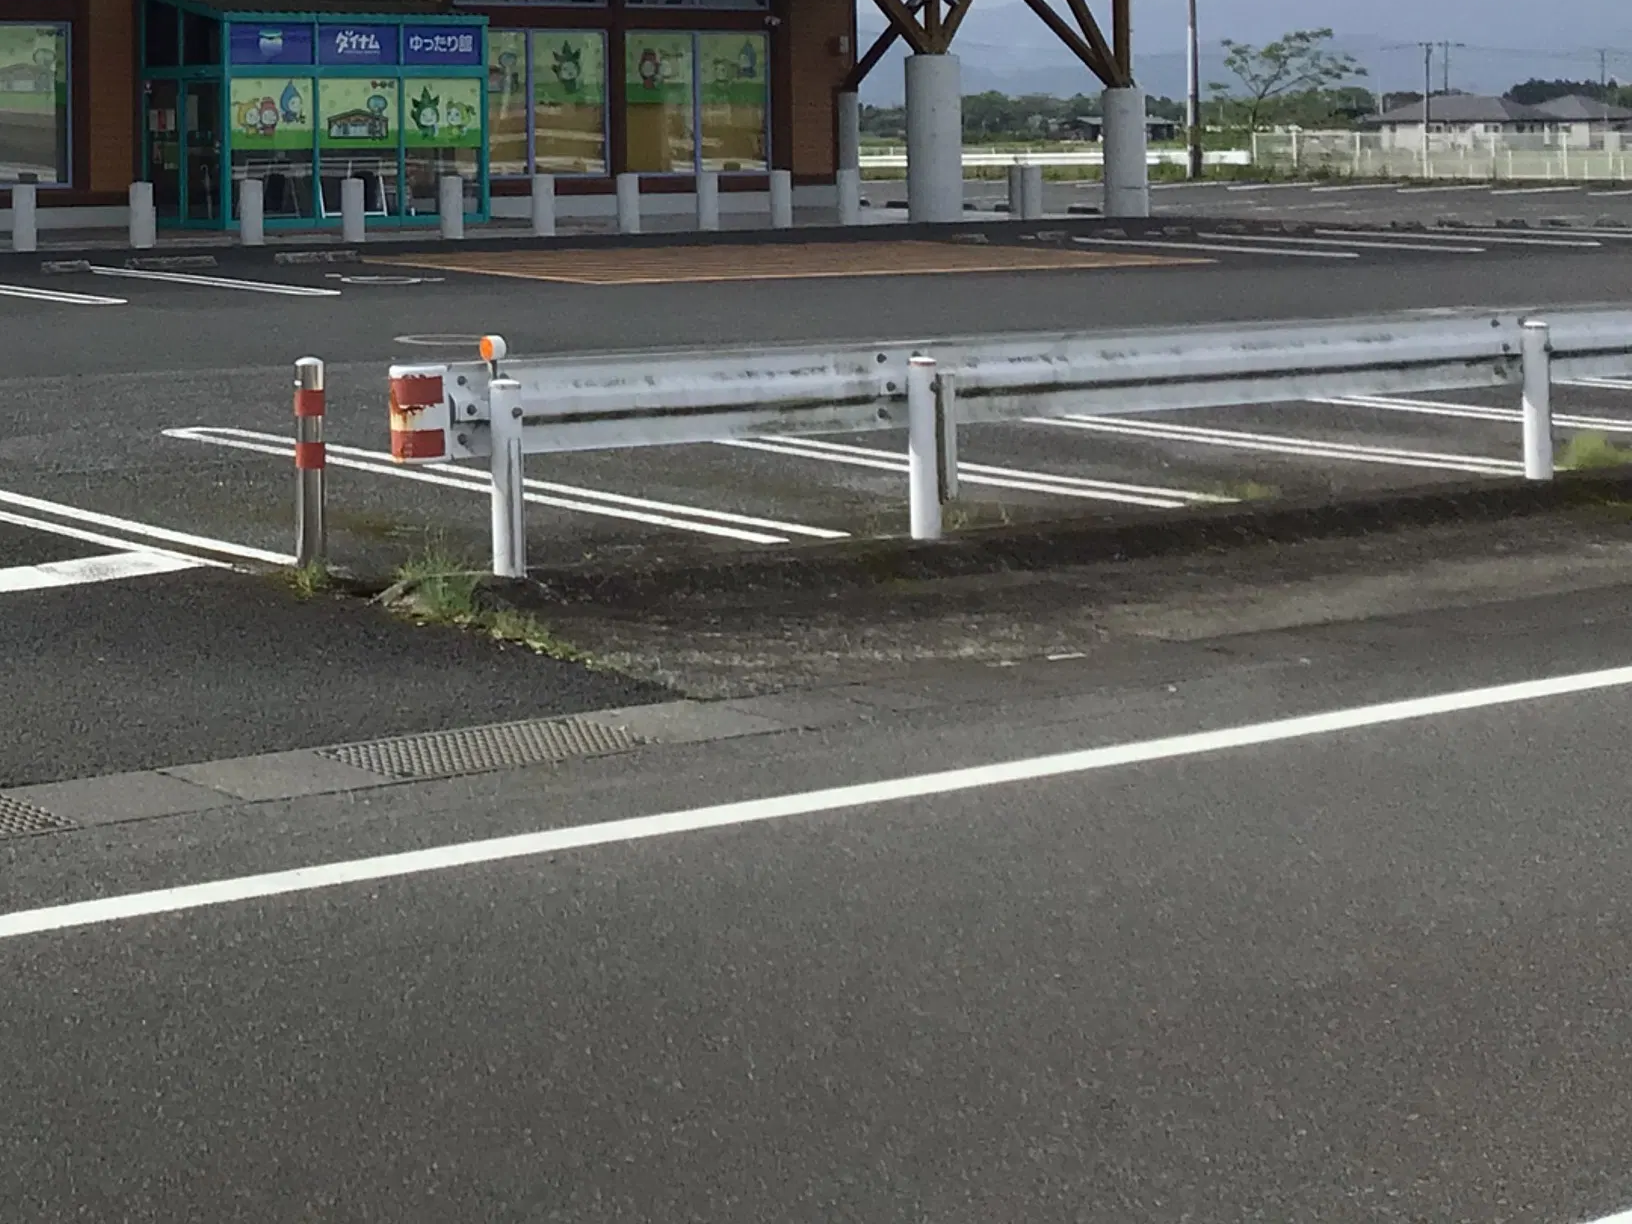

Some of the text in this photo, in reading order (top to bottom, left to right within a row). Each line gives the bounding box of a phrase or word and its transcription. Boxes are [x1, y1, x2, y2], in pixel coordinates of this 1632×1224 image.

[334, 29, 381, 54] ダイナム
[409, 34, 474, 53] ゆったり館
